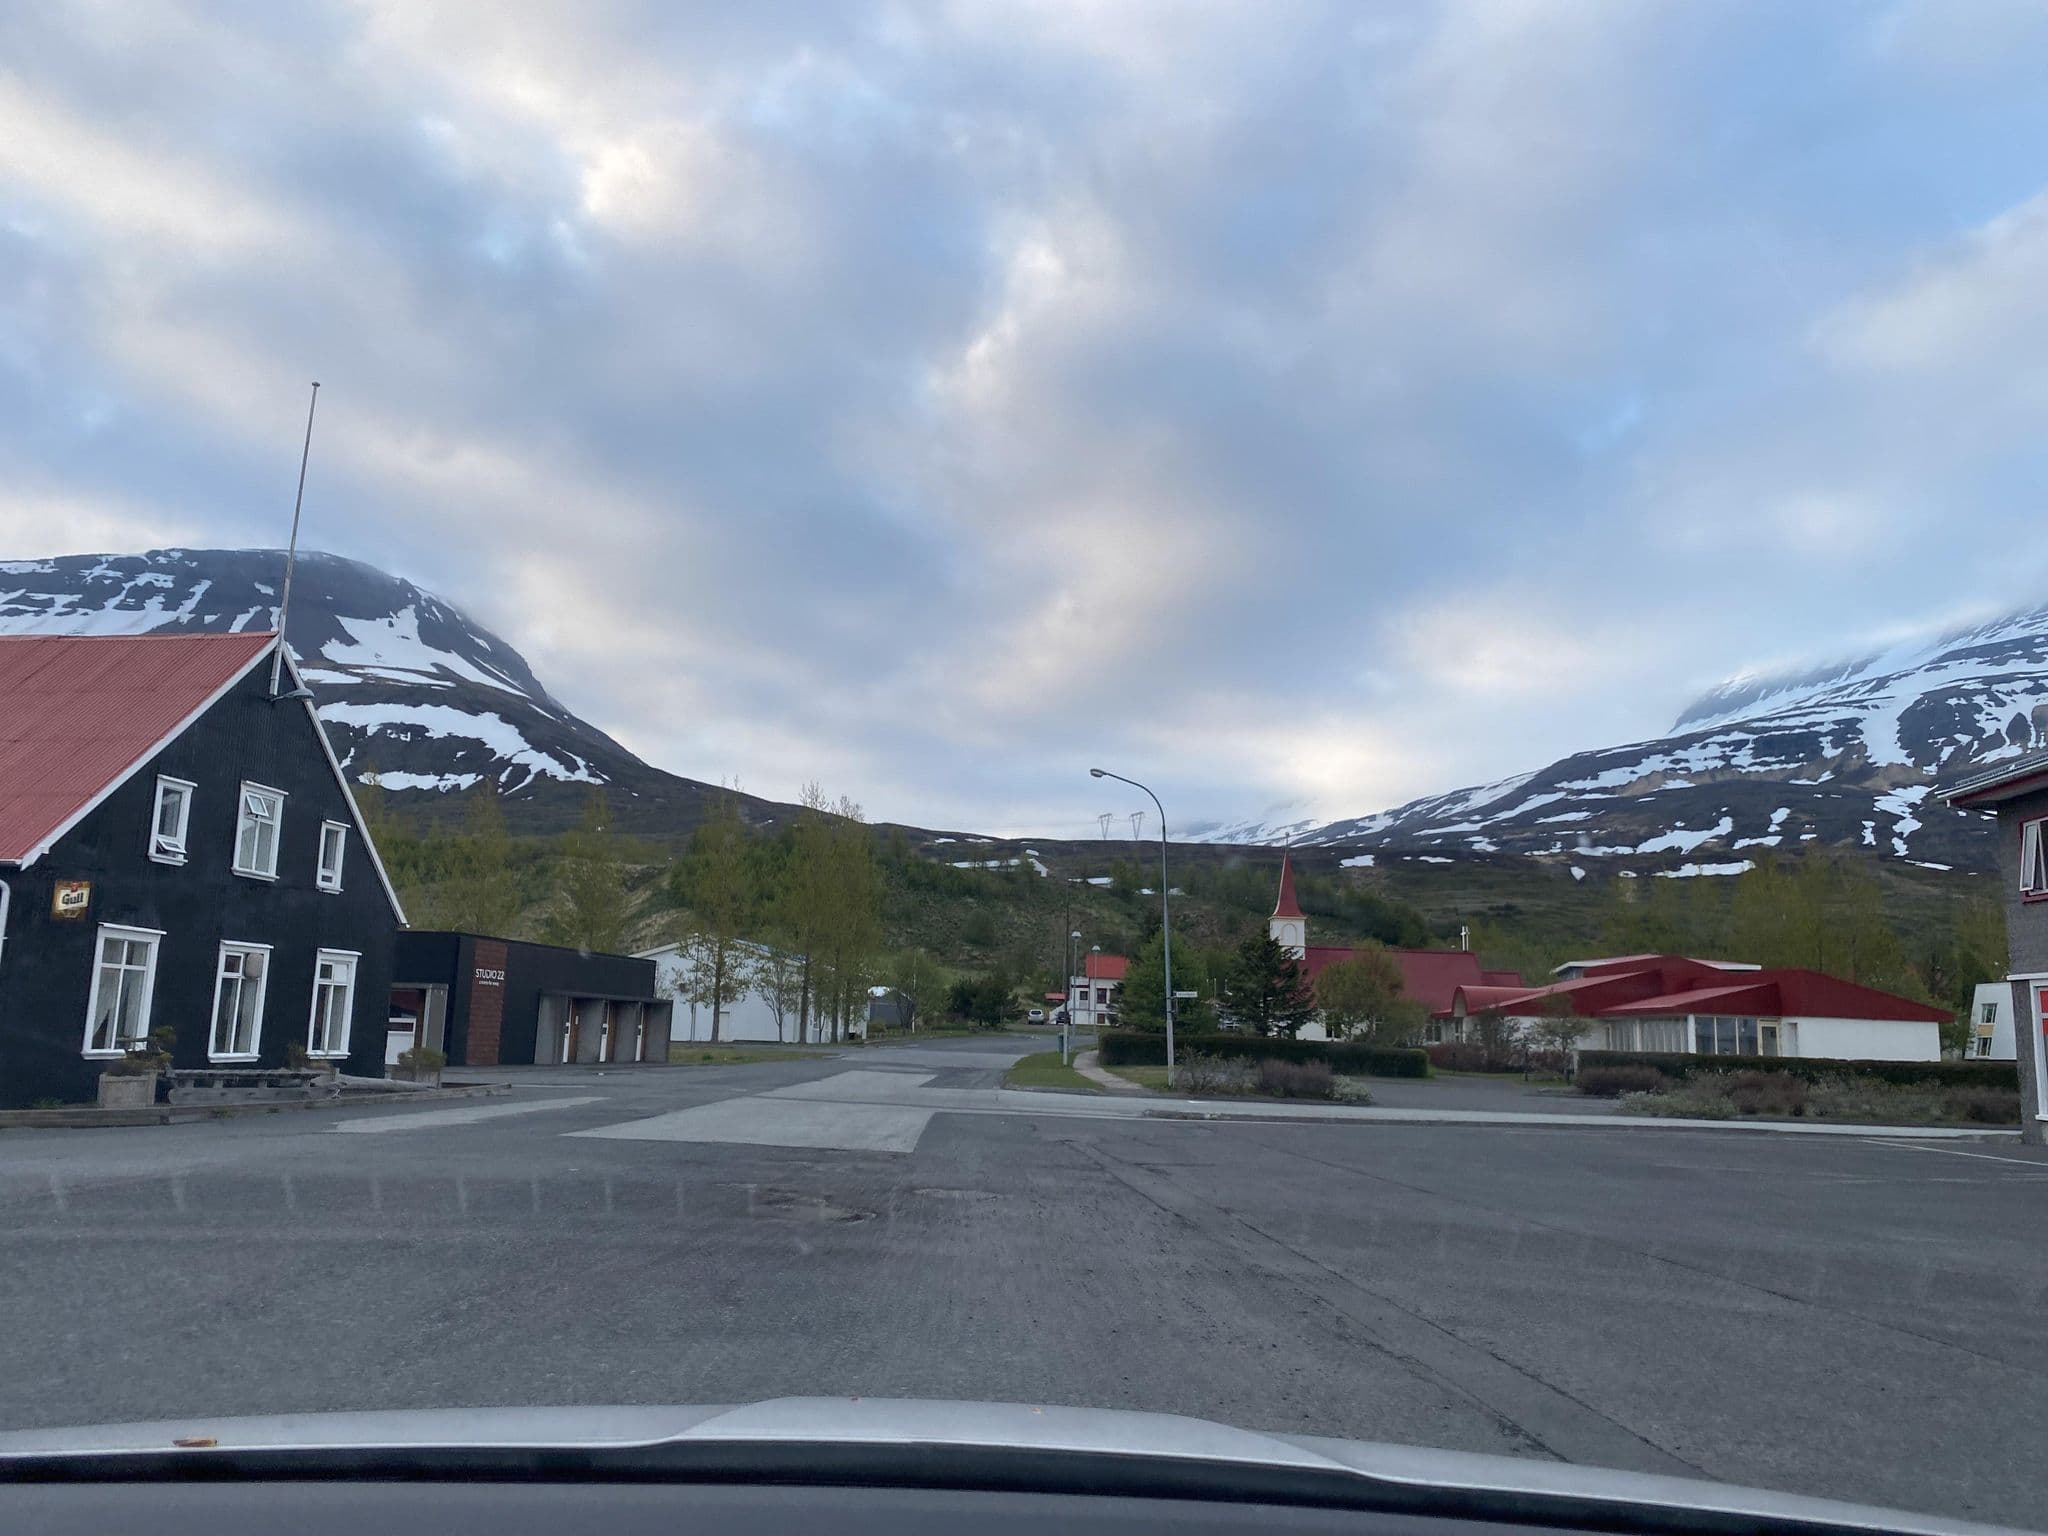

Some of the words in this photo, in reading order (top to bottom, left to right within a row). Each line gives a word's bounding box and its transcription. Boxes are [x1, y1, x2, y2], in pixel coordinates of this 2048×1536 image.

[62, 892, 84, 905] Gull
[475, 968, 497, 979] STUDIO
[497, 970, 505, 980] 22
